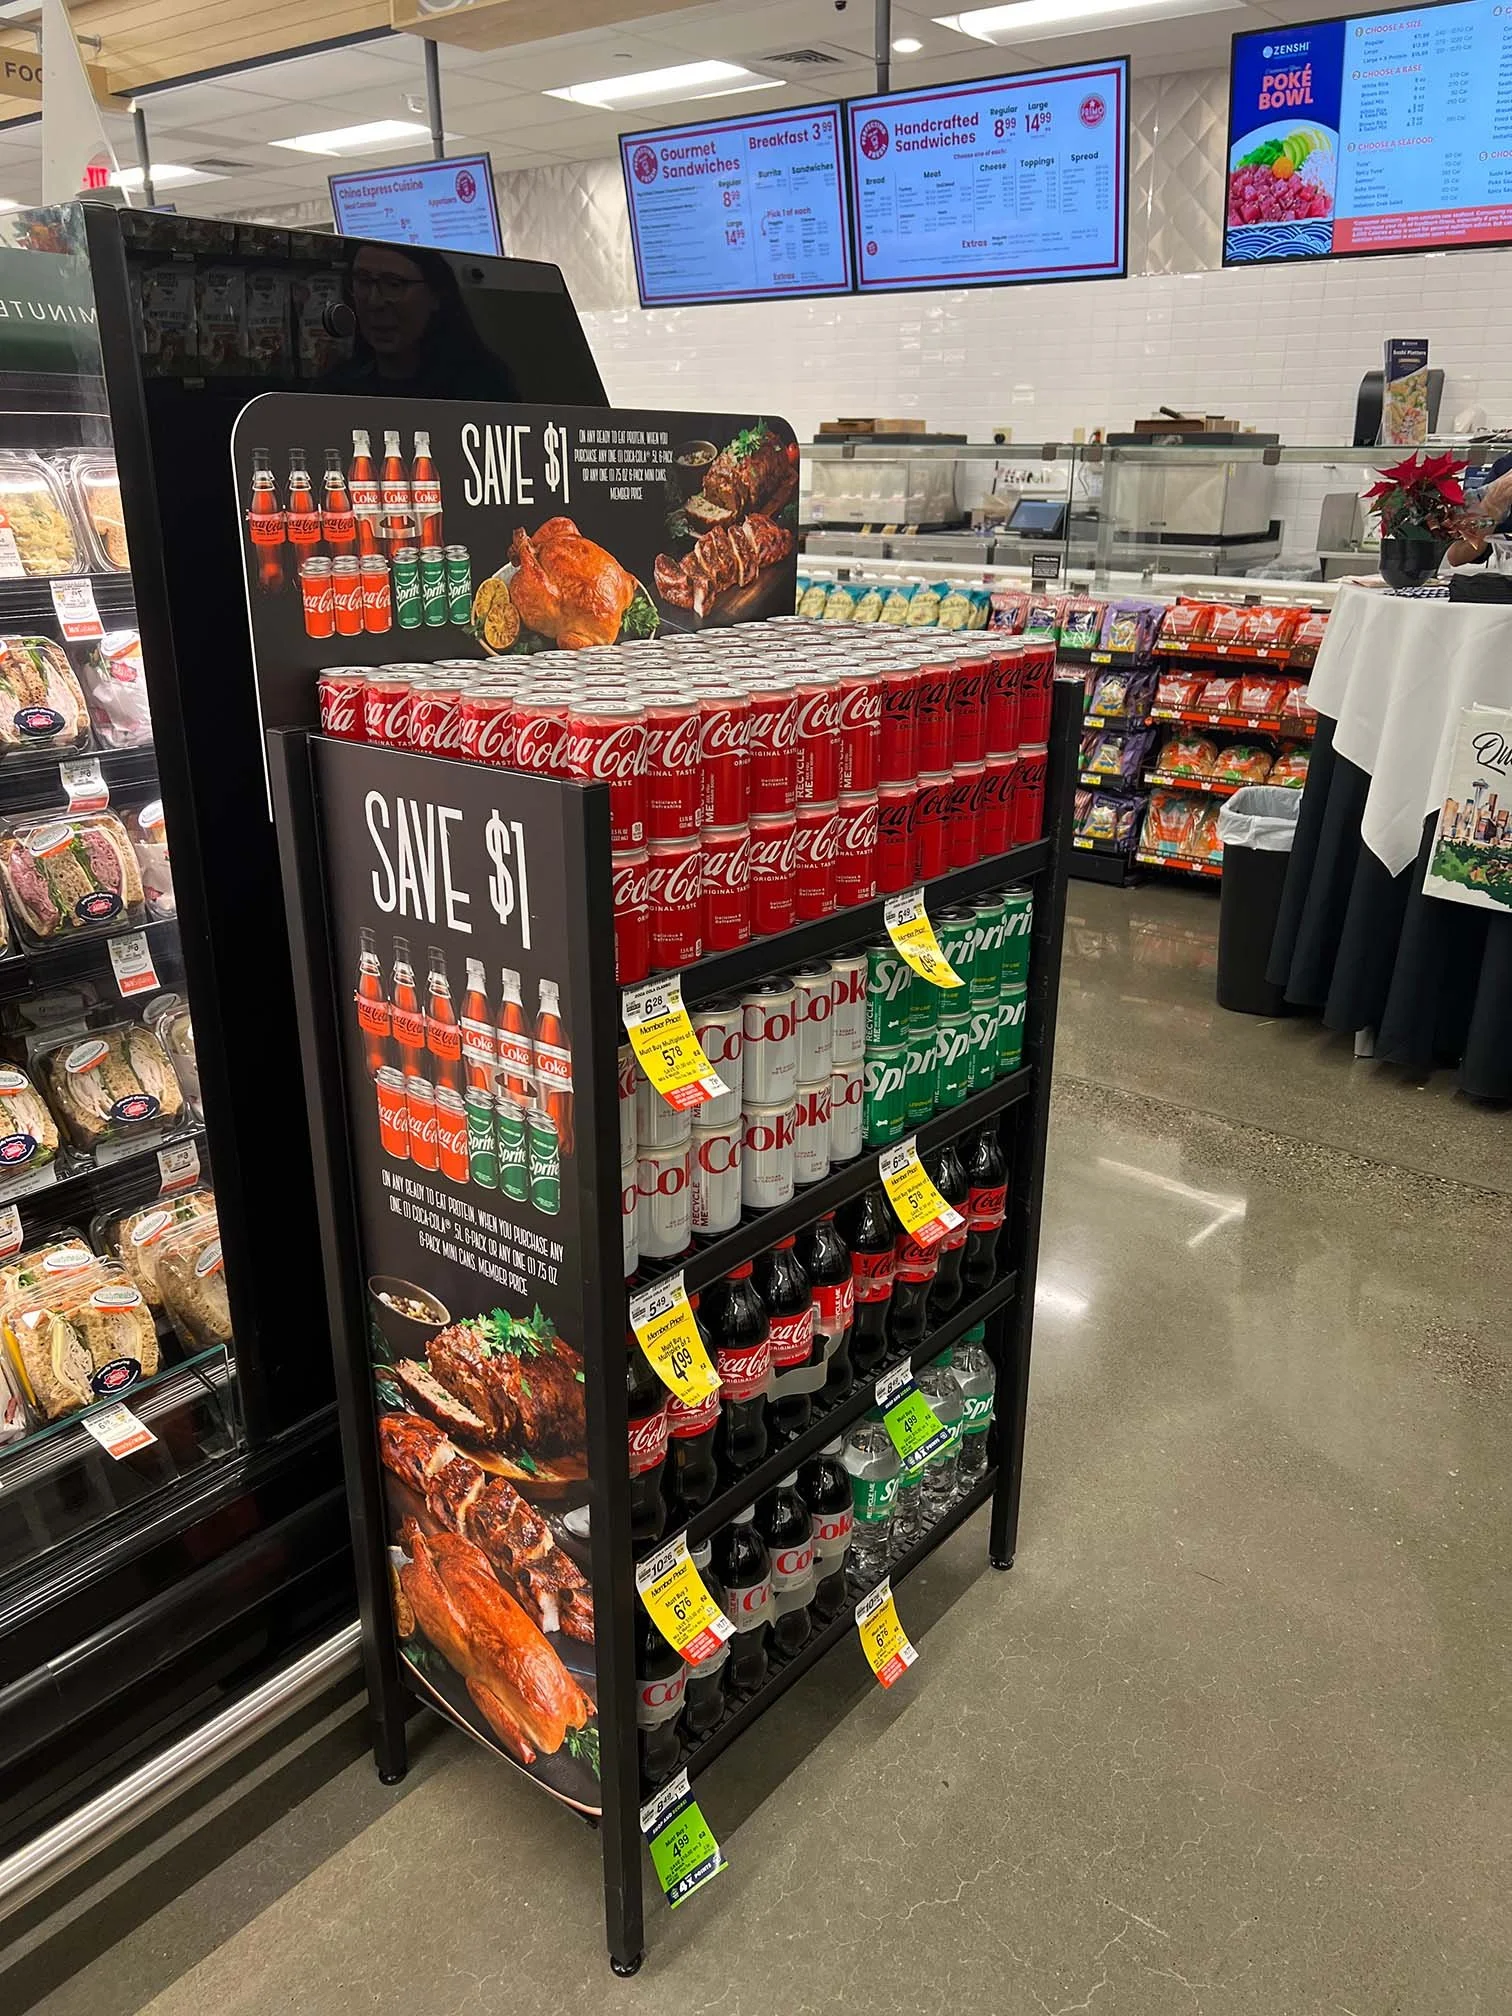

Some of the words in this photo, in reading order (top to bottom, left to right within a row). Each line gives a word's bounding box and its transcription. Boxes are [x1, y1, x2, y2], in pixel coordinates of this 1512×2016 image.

[1274, 41, 1308, 55] ZENSHI
[1262, 63, 1312, 92] POKÉ
[990, 105, 1018, 116] Regular
[1028, 101, 1048, 111] Large
[1258, 88, 1314, 110] BOWL
[895, 112, 979, 136] Handcrafted
[749, 128, 809, 149] Breakfast
[896, 132, 976, 153] Sandwiches
[661, 141, 716, 161] Gourmet
[1071, 152, 1099, 163] Spread
[663, 158, 740, 179] Sandwiches
[792, 163, 834, 174] Sandwiches
[980, 163, 1007, 172] Cheese
[1020, 157, 1054, 168] Toppings
[339, 185, 361, 200] China
[362, 182, 392, 198] Express
[393, 178, 423, 192] Cuisine
[866, 177, 885, 185] Bread
[962, 240, 987, 248] Extras
[579, 429, 586, 443] ON
[586, 430, 596, 443] ANY
[596, 430, 611, 443] READY
[611, 431, 618, 443] TO
[618, 431, 626, 444] EAT
[626, 431, 646, 445] PROTEIN,
[646, 431, 659, 445] WHEN
[659, 432, 668, 445] YOU
[461, 423, 534, 506] SAVE
[544, 422, 570, 504] $1
[574, 449, 598, 462] PURCHASE
[598, 450, 607, 462] ANY
[608, 450, 617, 463] ONE
[659, 450, 673, 463] 6-PACK
[583, 468, 589, 481] OR
[590, 468, 598, 481] ANY
[599, 468, 608, 481] ONE
[629, 469, 644, 481] 6-PACK
[644, 469, 654, 481] MINI
[353, 491, 378, 504] Coke
[384, 491, 408, 504] Coke
[415, 491, 439, 503] Coke
[610, 487, 631, 500] MEMBER
[631, 487, 643, 500] PRICE
[676, 768, 696, 776] TASTE
[796, 748, 804, 798] RECYCLE
[805, 780, 813, 799] ME
[365, 790, 472, 933] SAVE
[485, 809, 530, 950] $1
[677, 903, 697, 911] TASTE
[640, 1020, 664, 1035] Member
[866, 1000, 874, 1042] RECYCLE
[466, 1031, 494, 1051] Coke
[639, 1046, 652, 1056] Must
[652, 1043, 662, 1051] Buy
[663, 1035, 685, 1046] Multiples
[685, 1032, 691, 1040] of
[500, 1043, 529, 1064] Coke
[662, 1046, 683, 1067] 578
[537, 1055, 568, 1077] Coke
[692, 1182, 701, 1226] RECYCLE
[382, 1169, 390, 1187] ON
[392, 1173, 404, 1193] ANY
[405, 1178, 425, 1201] READY
[425, 1186, 435, 1205] TO
[435, 1191, 447, 1209] EAT
[448, 1196, 477, 1225] PROTEIN,
[478, 1209, 497, 1234] WHEN
[499, 1217, 512, 1240] YOU
[513, 1224, 548, 1257] PURCHASE
[550, 1239, 564, 1263] ANY
[389, 1195, 403, 1216] ONE
[464, 1226, 487, 1252] 6-PACK
[489, 1234, 498, 1254] OR
[498, 1239, 511, 1264] ANY
[512, 1249, 526, 1272] ONE
[548, 1266, 558, 1286] OZ
[418, 1230, 441, 1255] 6-PACK
[442, 1239, 457, 1263] MINI
[479, 1256, 508, 1287] MEMBER
[509, 1270, 528, 1296] PRICE
[647, 1323, 669, 1341] Member
[670, 1313, 685, 1328] Price!
[658, 1345, 681, 1361] Multiples
[661, 1341, 673, 1353] Must
[673, 1336, 682, 1346] Buy
[671, 1348, 693, 1381] 499
[904, 1415, 918, 1433] 499
[651, 1576, 672, 1598] Member
[673, 1564, 687, 1581] Price!
[665, 1596, 677, 1608] Must
[677, 1590, 685, 1600] Buy
[673, 1596, 692, 1620] 676
[876, 1627, 888, 1647] 676
[665, 1837, 675, 1848] Must
[675, 1829, 684, 1840] Buy
[673, 1834, 689, 1857] 499
[694, 1863, 712, 1879] POINTS
